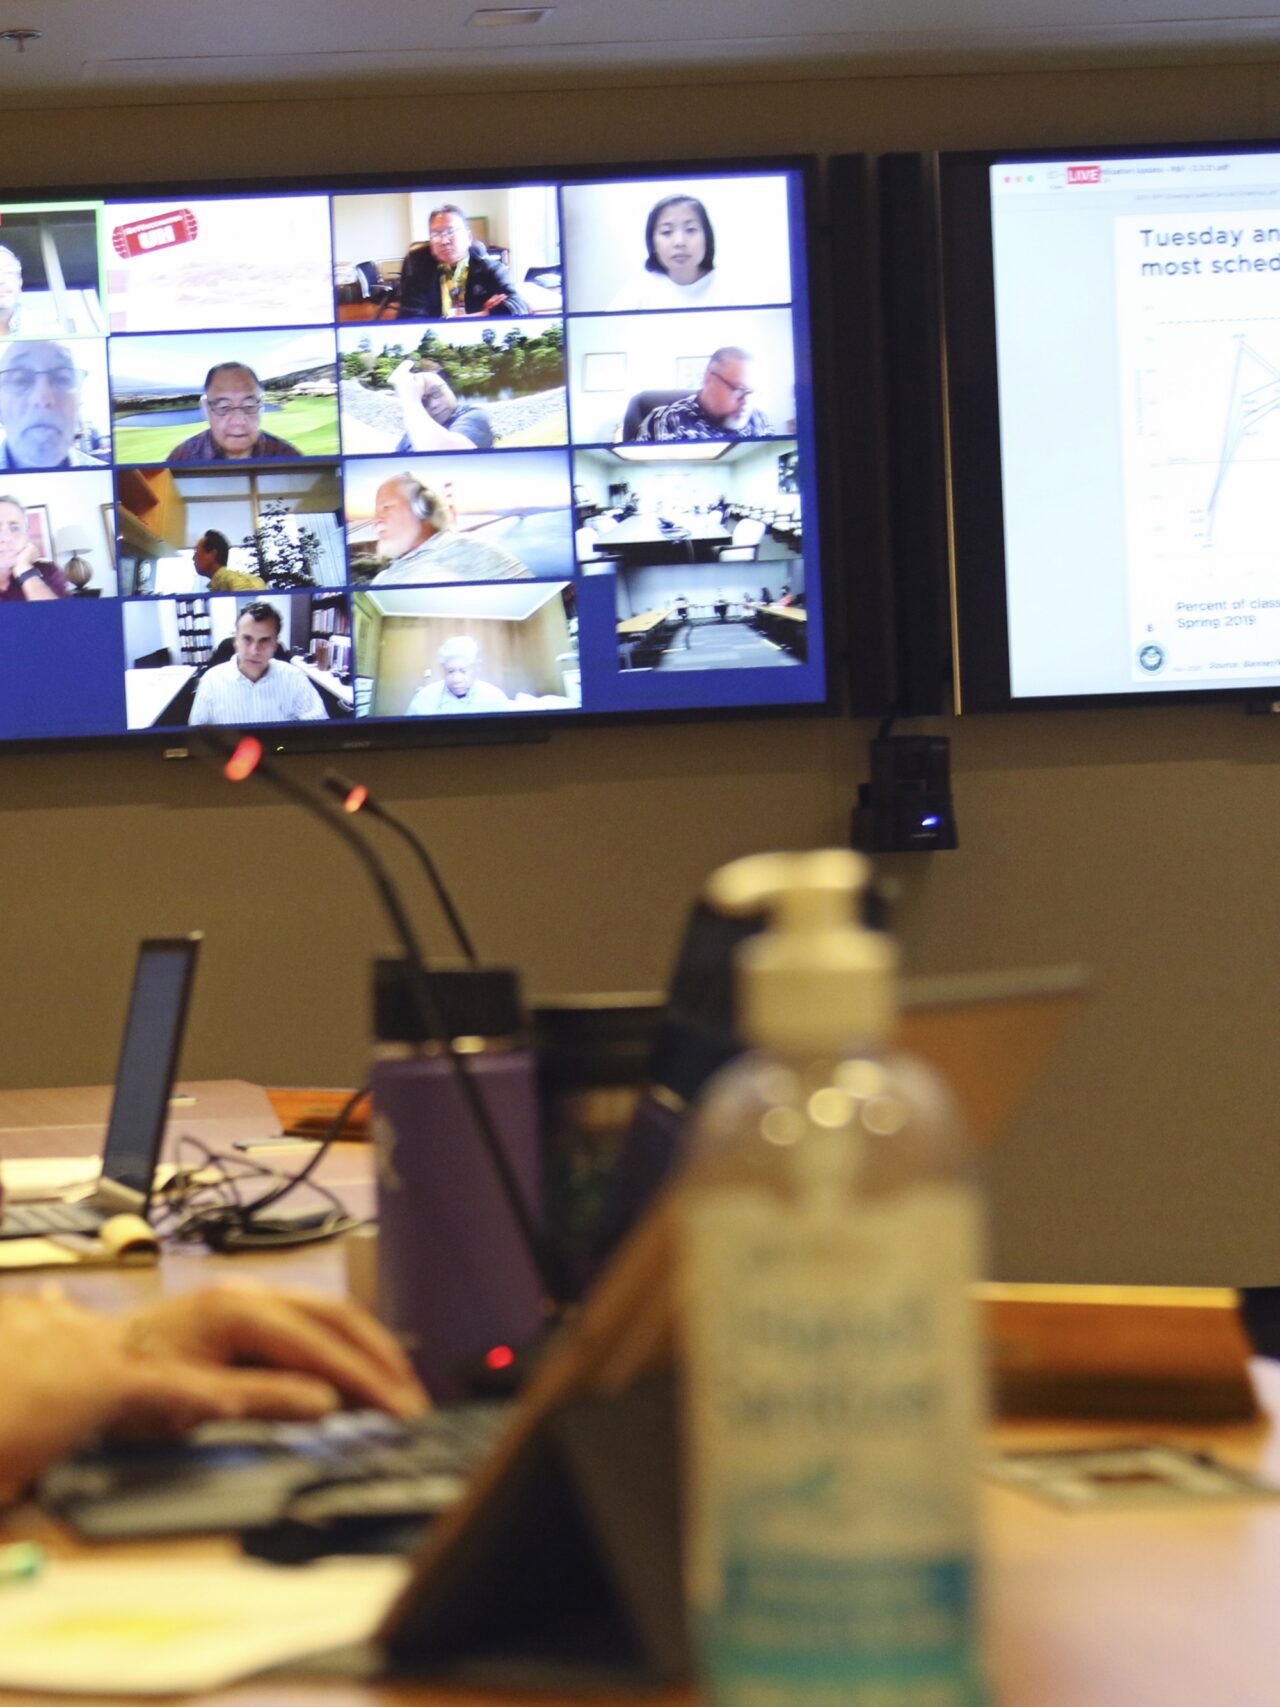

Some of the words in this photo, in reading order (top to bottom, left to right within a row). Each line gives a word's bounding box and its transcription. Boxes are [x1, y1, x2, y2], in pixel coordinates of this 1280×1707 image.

[1069, 169, 1099, 183] LIVE
[1139, 226, 1243, 247] Tuesday
[1253, 228, 1280, 243] an
[1142, 257, 1202, 277] most
[1211, 253, 1280, 274] sched
[1176, 600, 1227, 612] Percent
[1231, 598, 1245, 610] of
[1249, 597, 1280, 609] class
[1176, 616, 1220, 629] Spring
[1224, 614, 1257, 627] 2019
